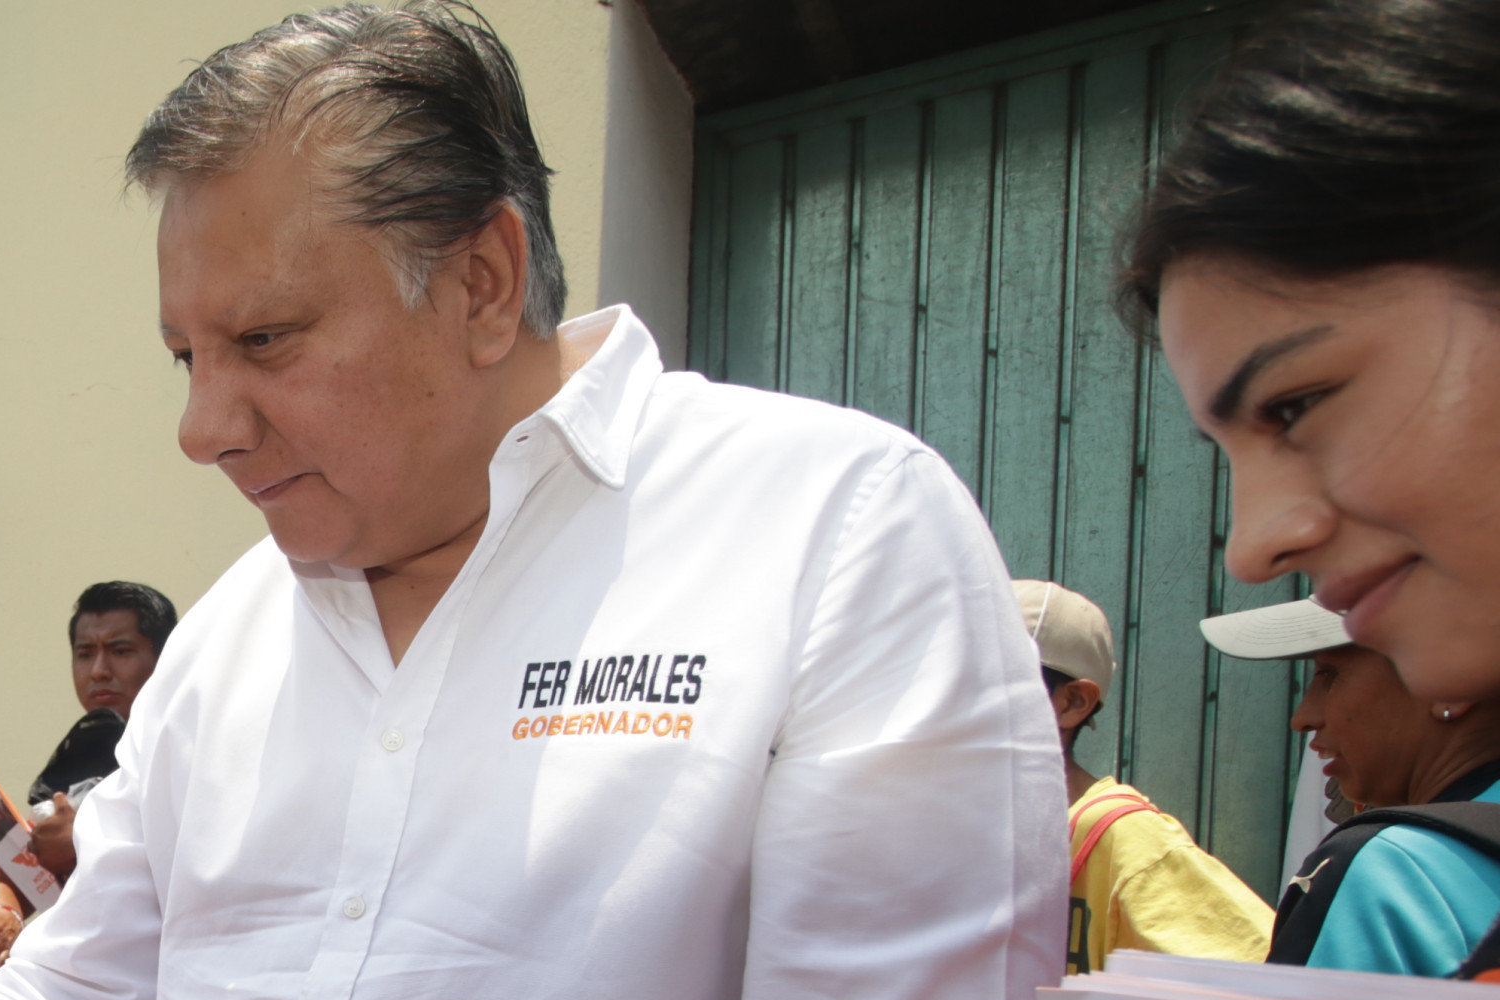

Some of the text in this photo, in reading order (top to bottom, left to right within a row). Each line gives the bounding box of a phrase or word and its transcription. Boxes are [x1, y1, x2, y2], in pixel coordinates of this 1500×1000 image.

[517, 654, 707, 709] FER MORALES
[512, 711, 694, 740] GOBERNADOR
